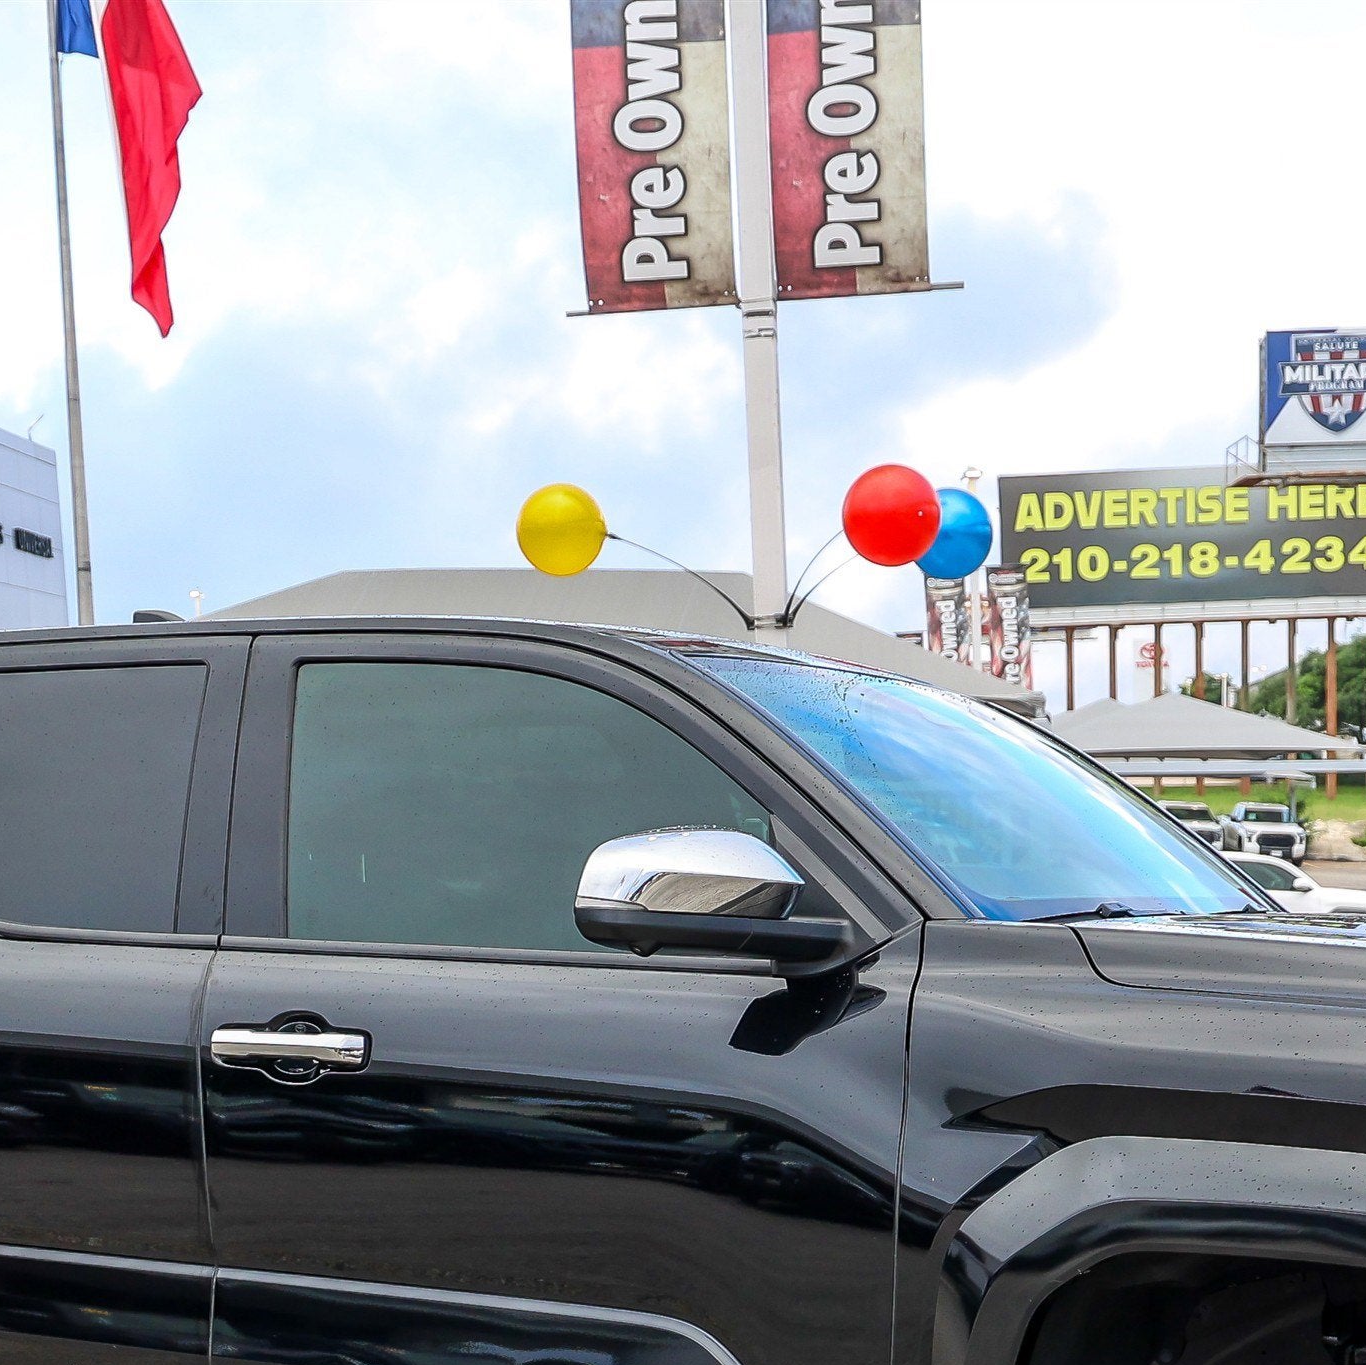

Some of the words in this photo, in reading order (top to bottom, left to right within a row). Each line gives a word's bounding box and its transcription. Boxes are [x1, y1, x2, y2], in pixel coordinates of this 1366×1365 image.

[622, 165, 689, 282] Pre
[814, 151, 882, 268] Pre
[1314, 341, 1359, 351] SALUTE
[1014, 485, 1250, 532] ADVERTISE
[935, 600, 959, 661] Owned
[996, 596, 1020, 662] Owned
